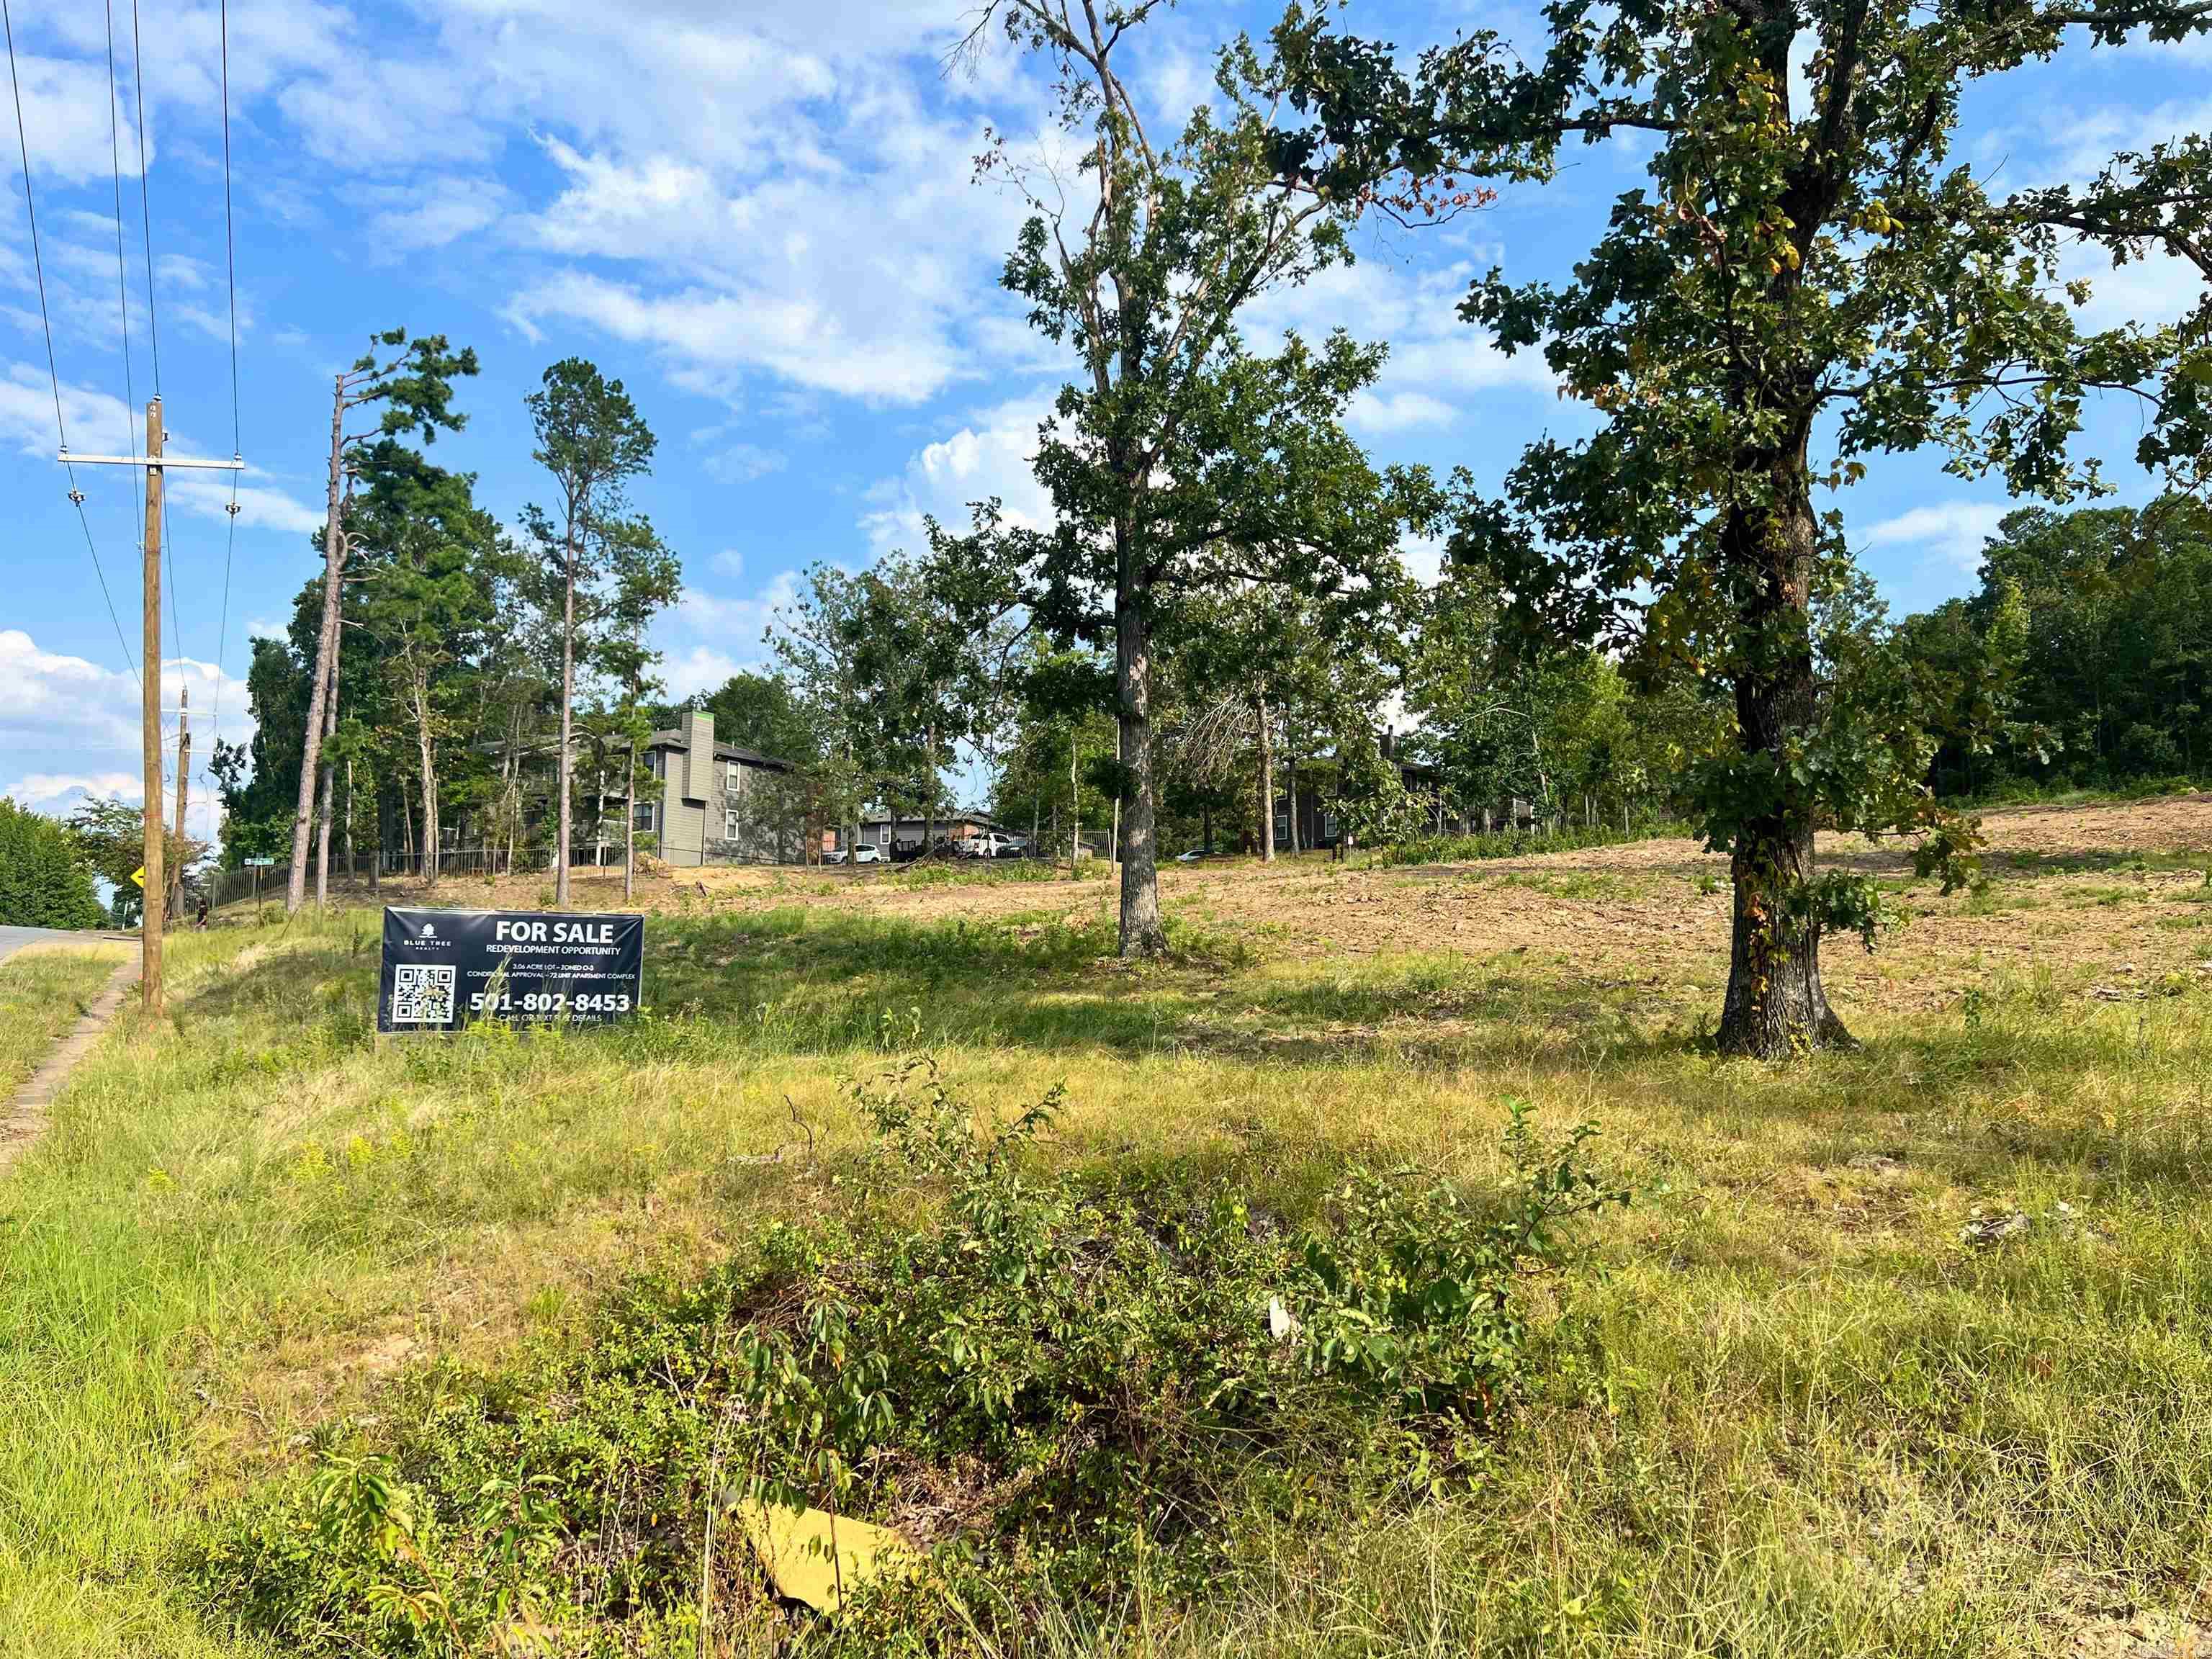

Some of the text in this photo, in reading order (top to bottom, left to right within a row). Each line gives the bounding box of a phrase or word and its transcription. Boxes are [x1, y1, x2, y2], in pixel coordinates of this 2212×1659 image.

[496, 921, 614, 944] FOR SALE
[486, 944, 621, 956] REDEVELOPMENT OPPORTUNITY
[470, 993, 629, 1012] 501-802-8453
[572, 1014, 602, 1022] DETAILS
